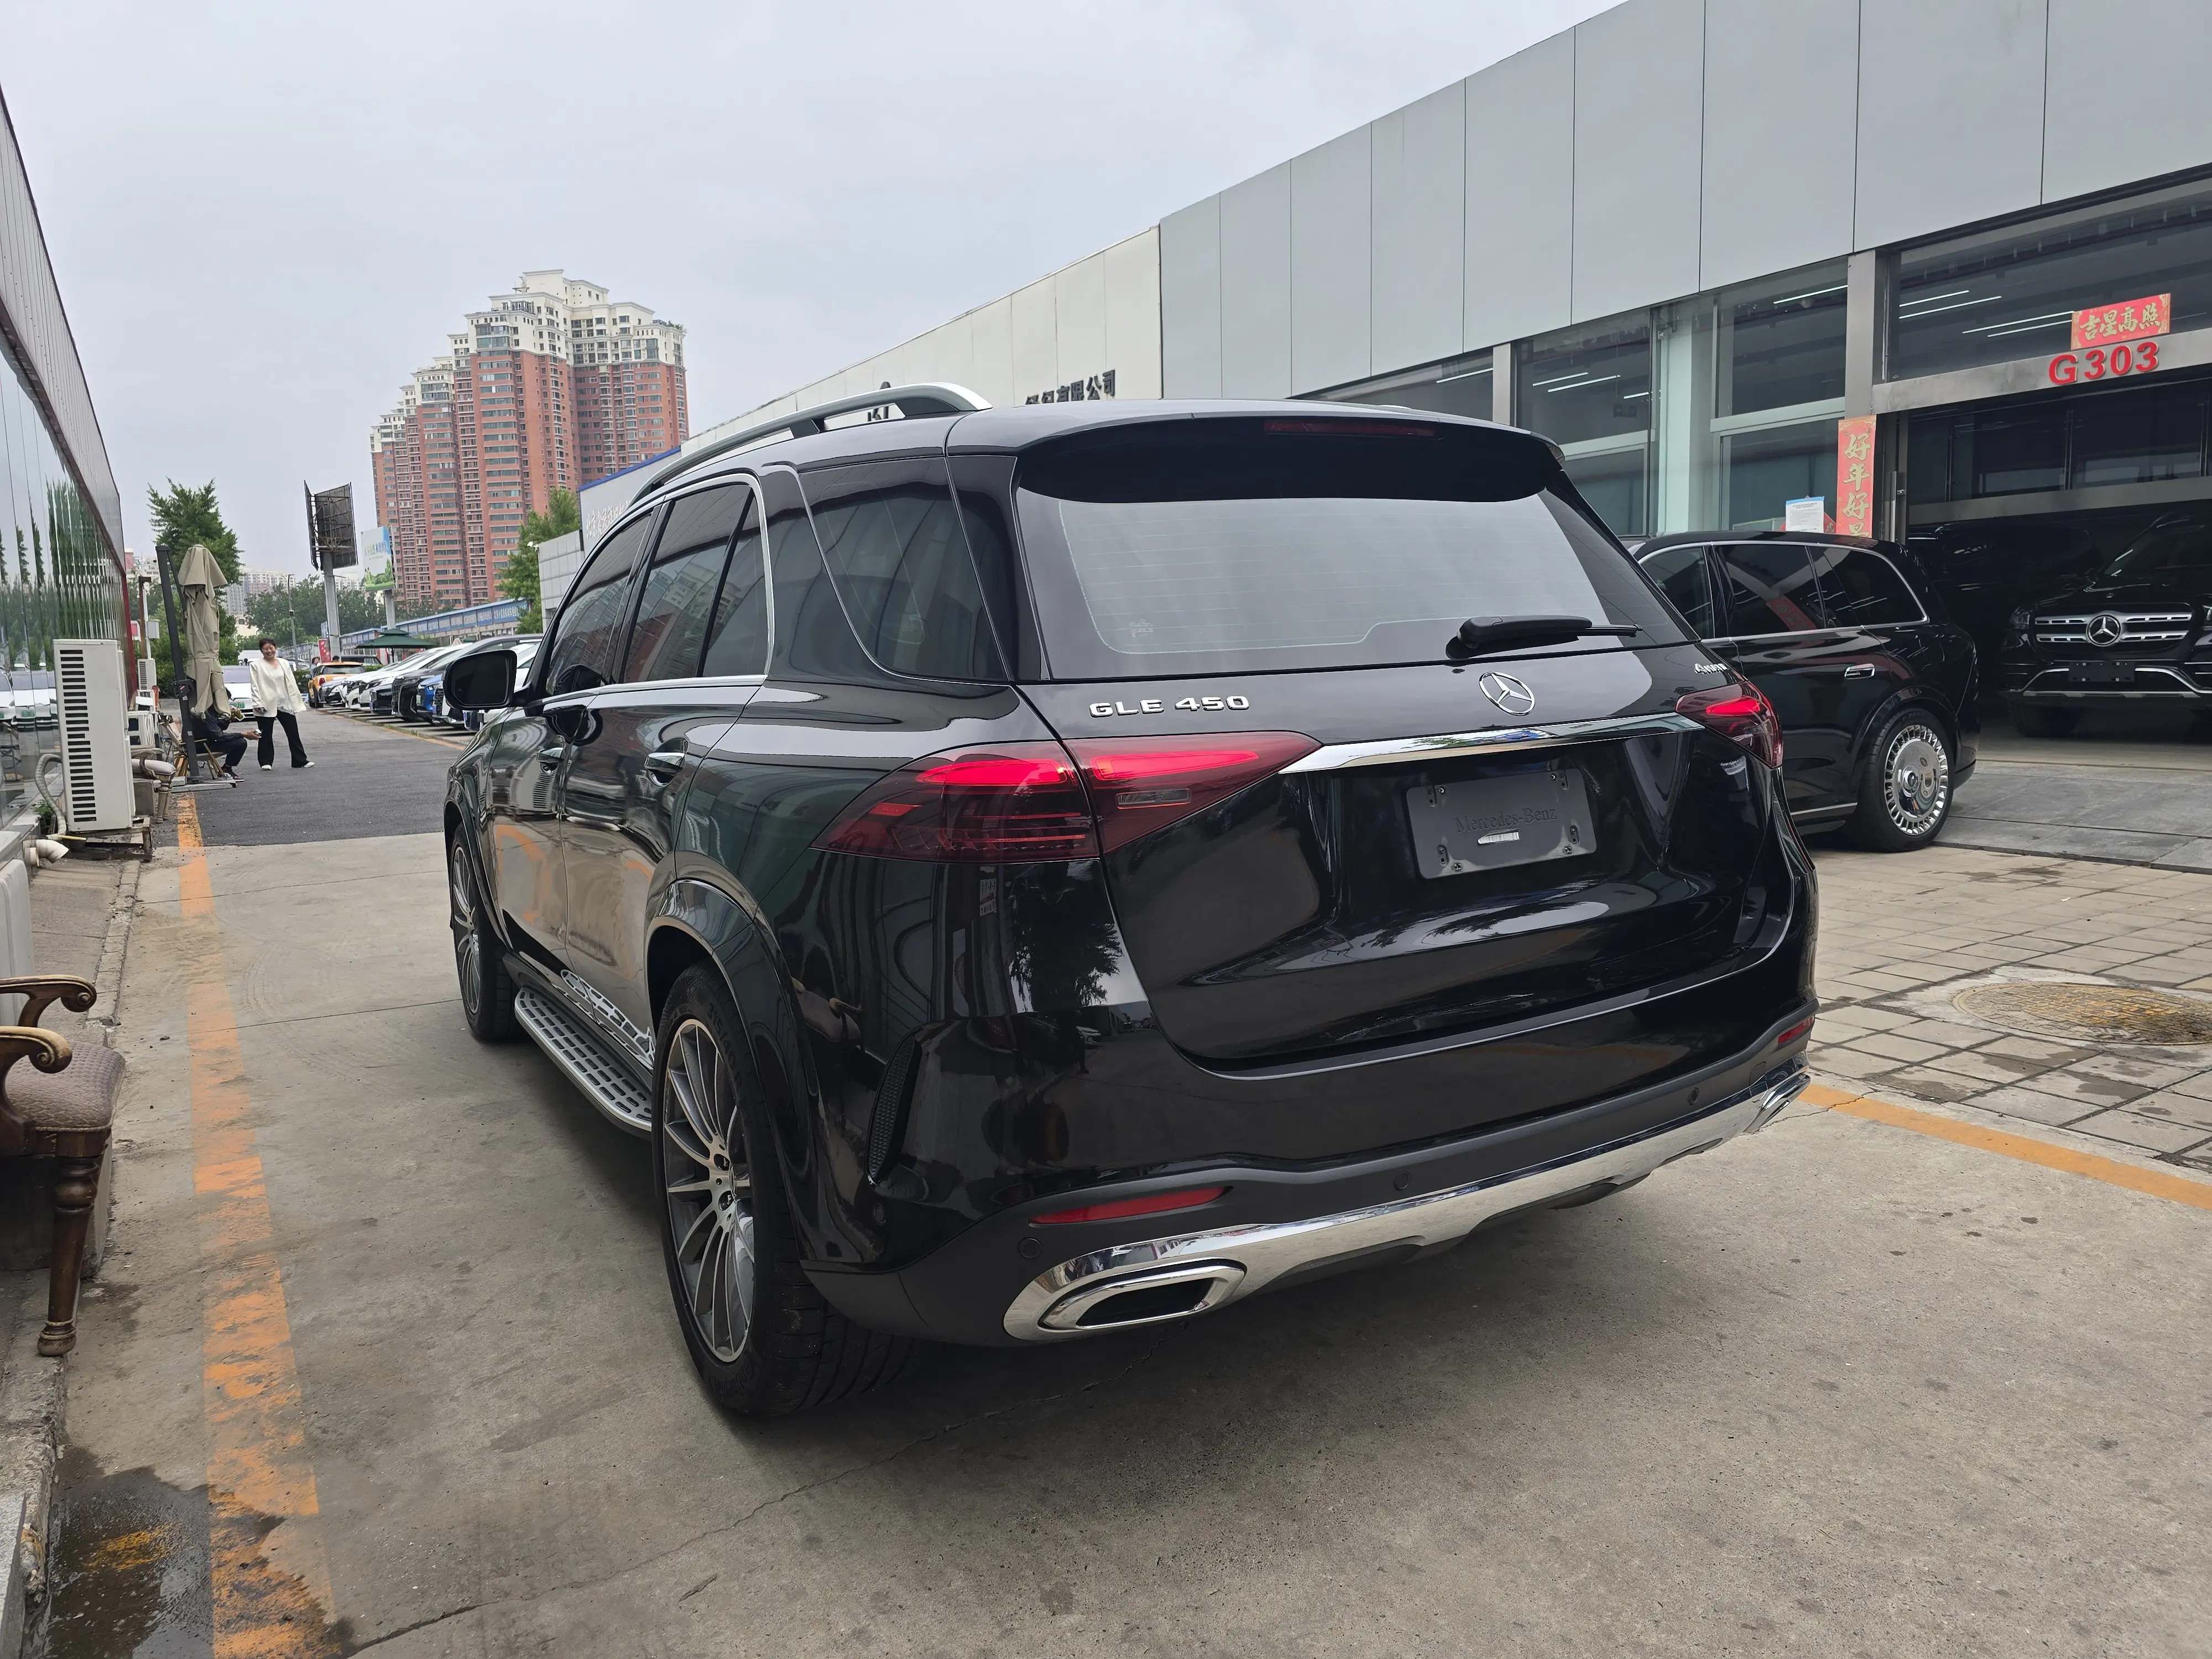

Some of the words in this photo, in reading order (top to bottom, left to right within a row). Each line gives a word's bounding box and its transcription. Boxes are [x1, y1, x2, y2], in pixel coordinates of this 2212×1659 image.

[2079, 302, 2161, 341] 吉星高照
[2048, 341, 2159, 385] G303
[1089, 699, 1165, 718] GLE
[1173, 696, 1250, 712] 450
[1454, 807, 1558, 834] Mercedes-Benz
